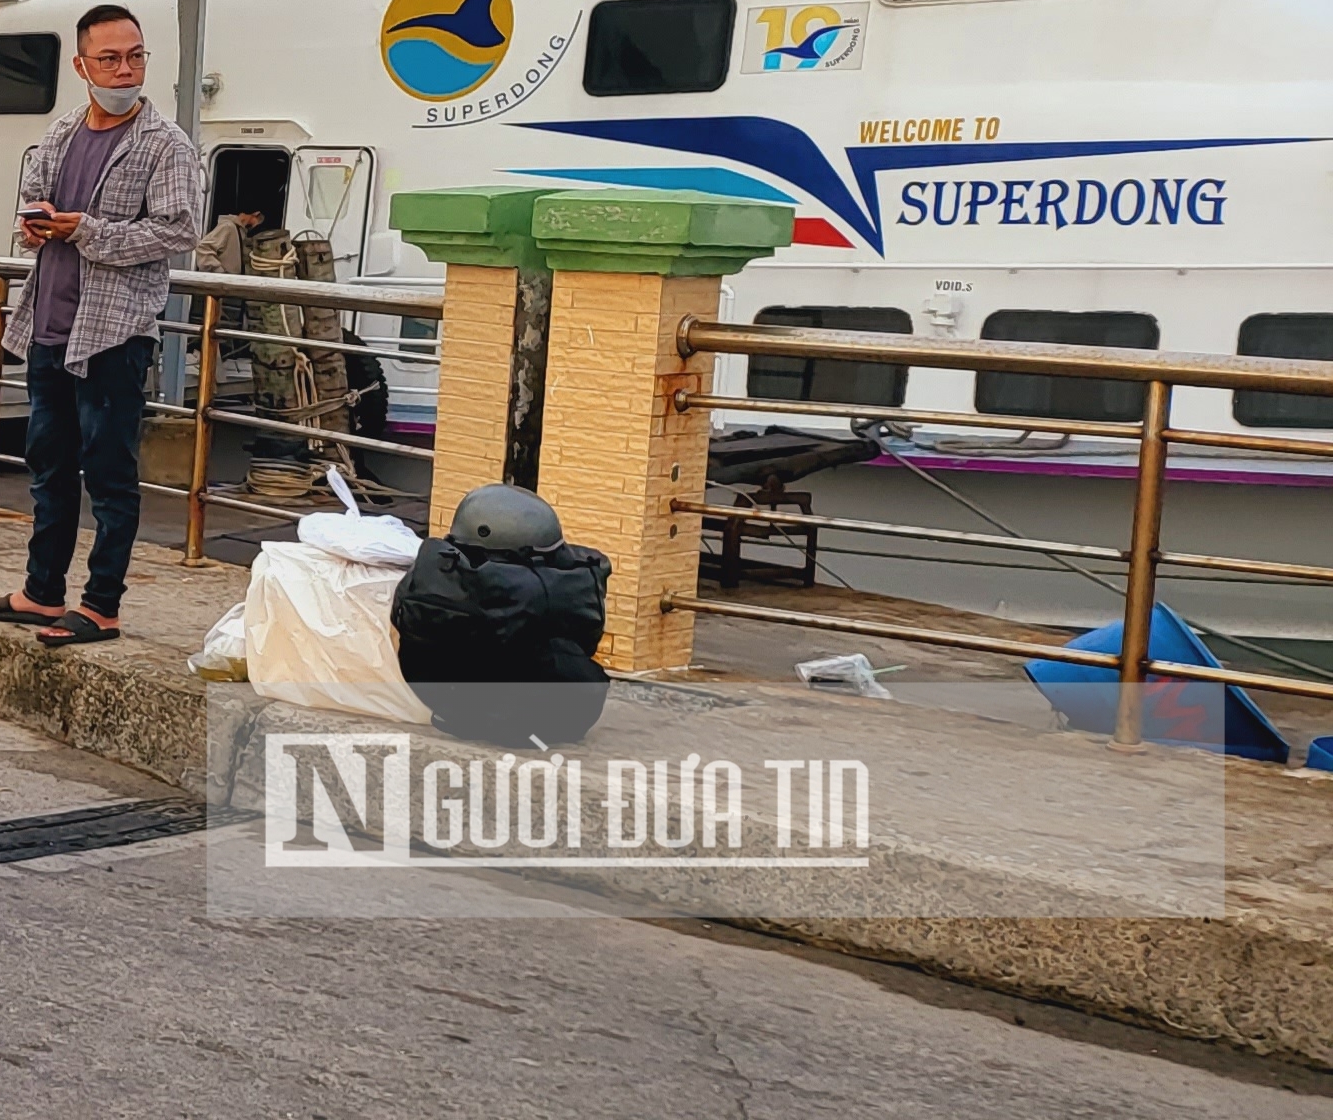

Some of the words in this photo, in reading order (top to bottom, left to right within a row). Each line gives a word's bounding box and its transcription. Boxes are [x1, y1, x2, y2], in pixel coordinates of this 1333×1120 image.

[426, 34, 566, 123] SUPERDONG
[859, 117, 965, 143] WELCOME
[974, 116, 1000, 140] TO
[895, 178, 1228, 230] SUPERDONG
